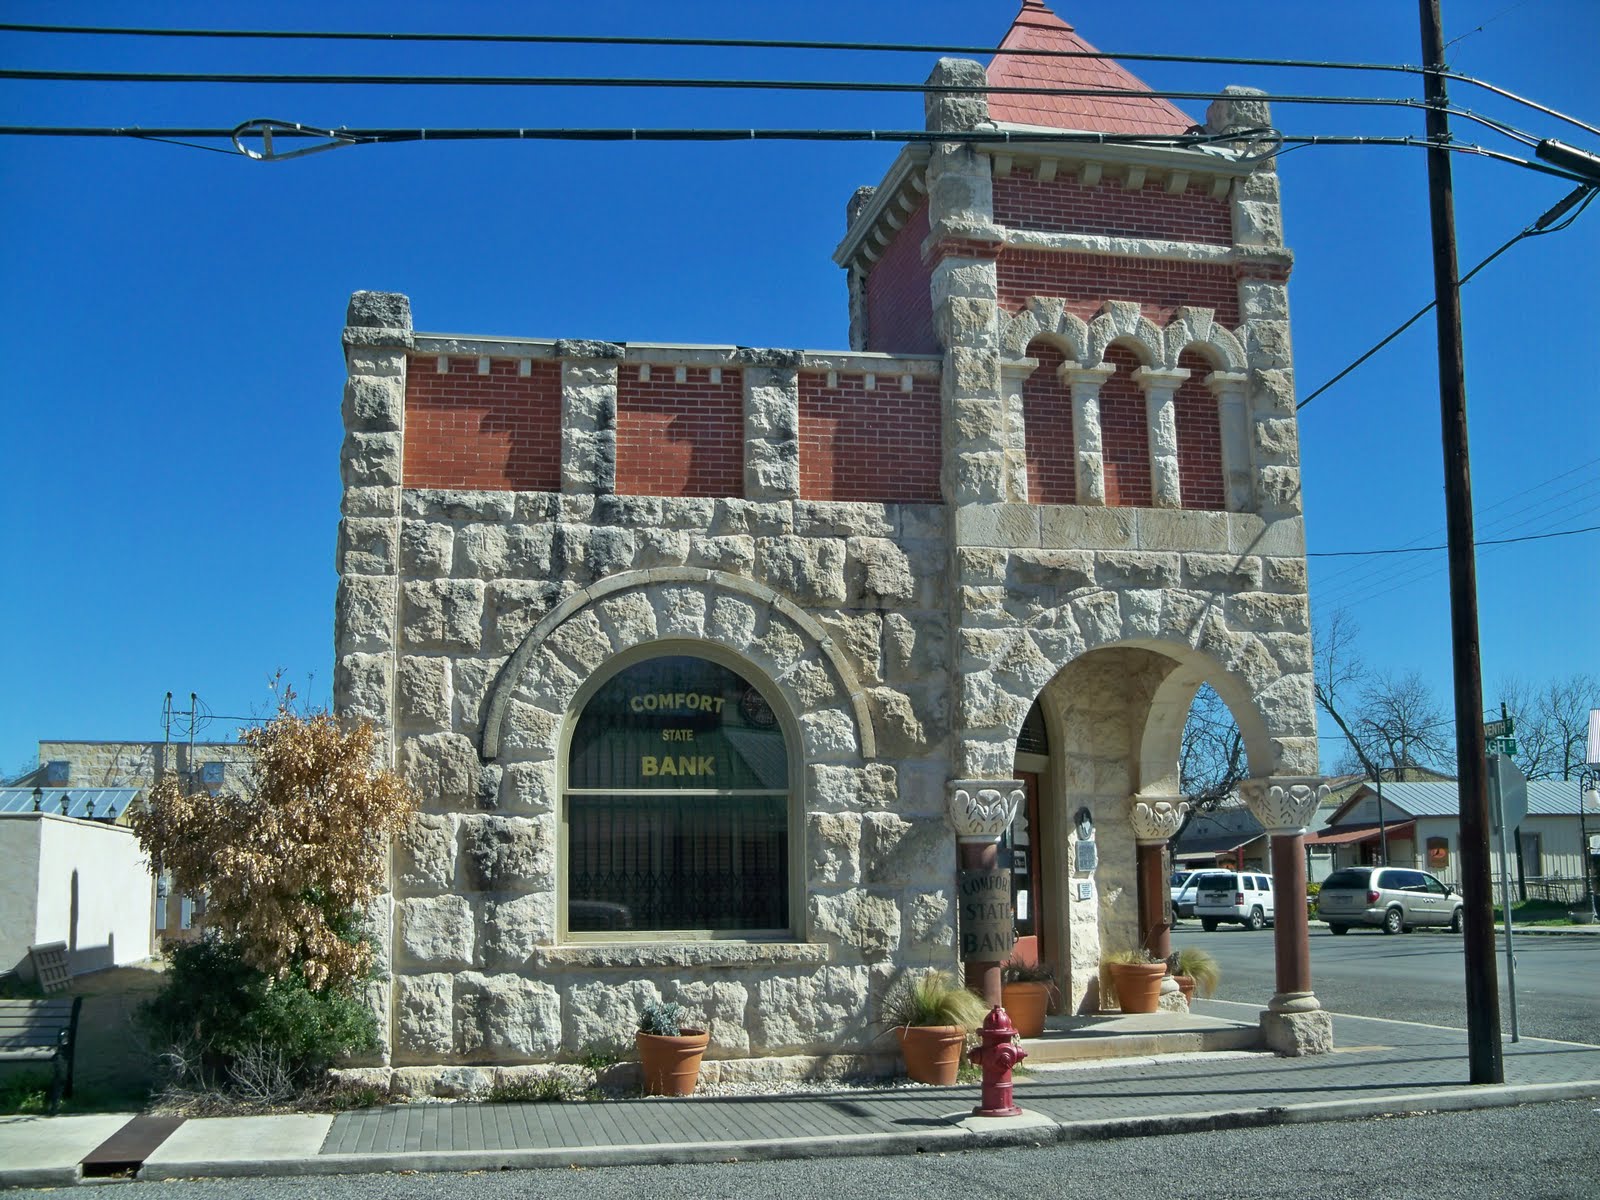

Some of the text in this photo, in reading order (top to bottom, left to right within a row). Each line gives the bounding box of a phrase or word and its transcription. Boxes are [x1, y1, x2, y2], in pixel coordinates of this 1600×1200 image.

[630, 692, 726, 714] COMFORT
[662, 729, 694, 742] STATE
[1483, 721, 1506, 736] VENTH
[1484, 740, 1506, 753] IGH
[641, 756, 716, 776] BANK
[962, 875, 1011, 896] COMFOR
